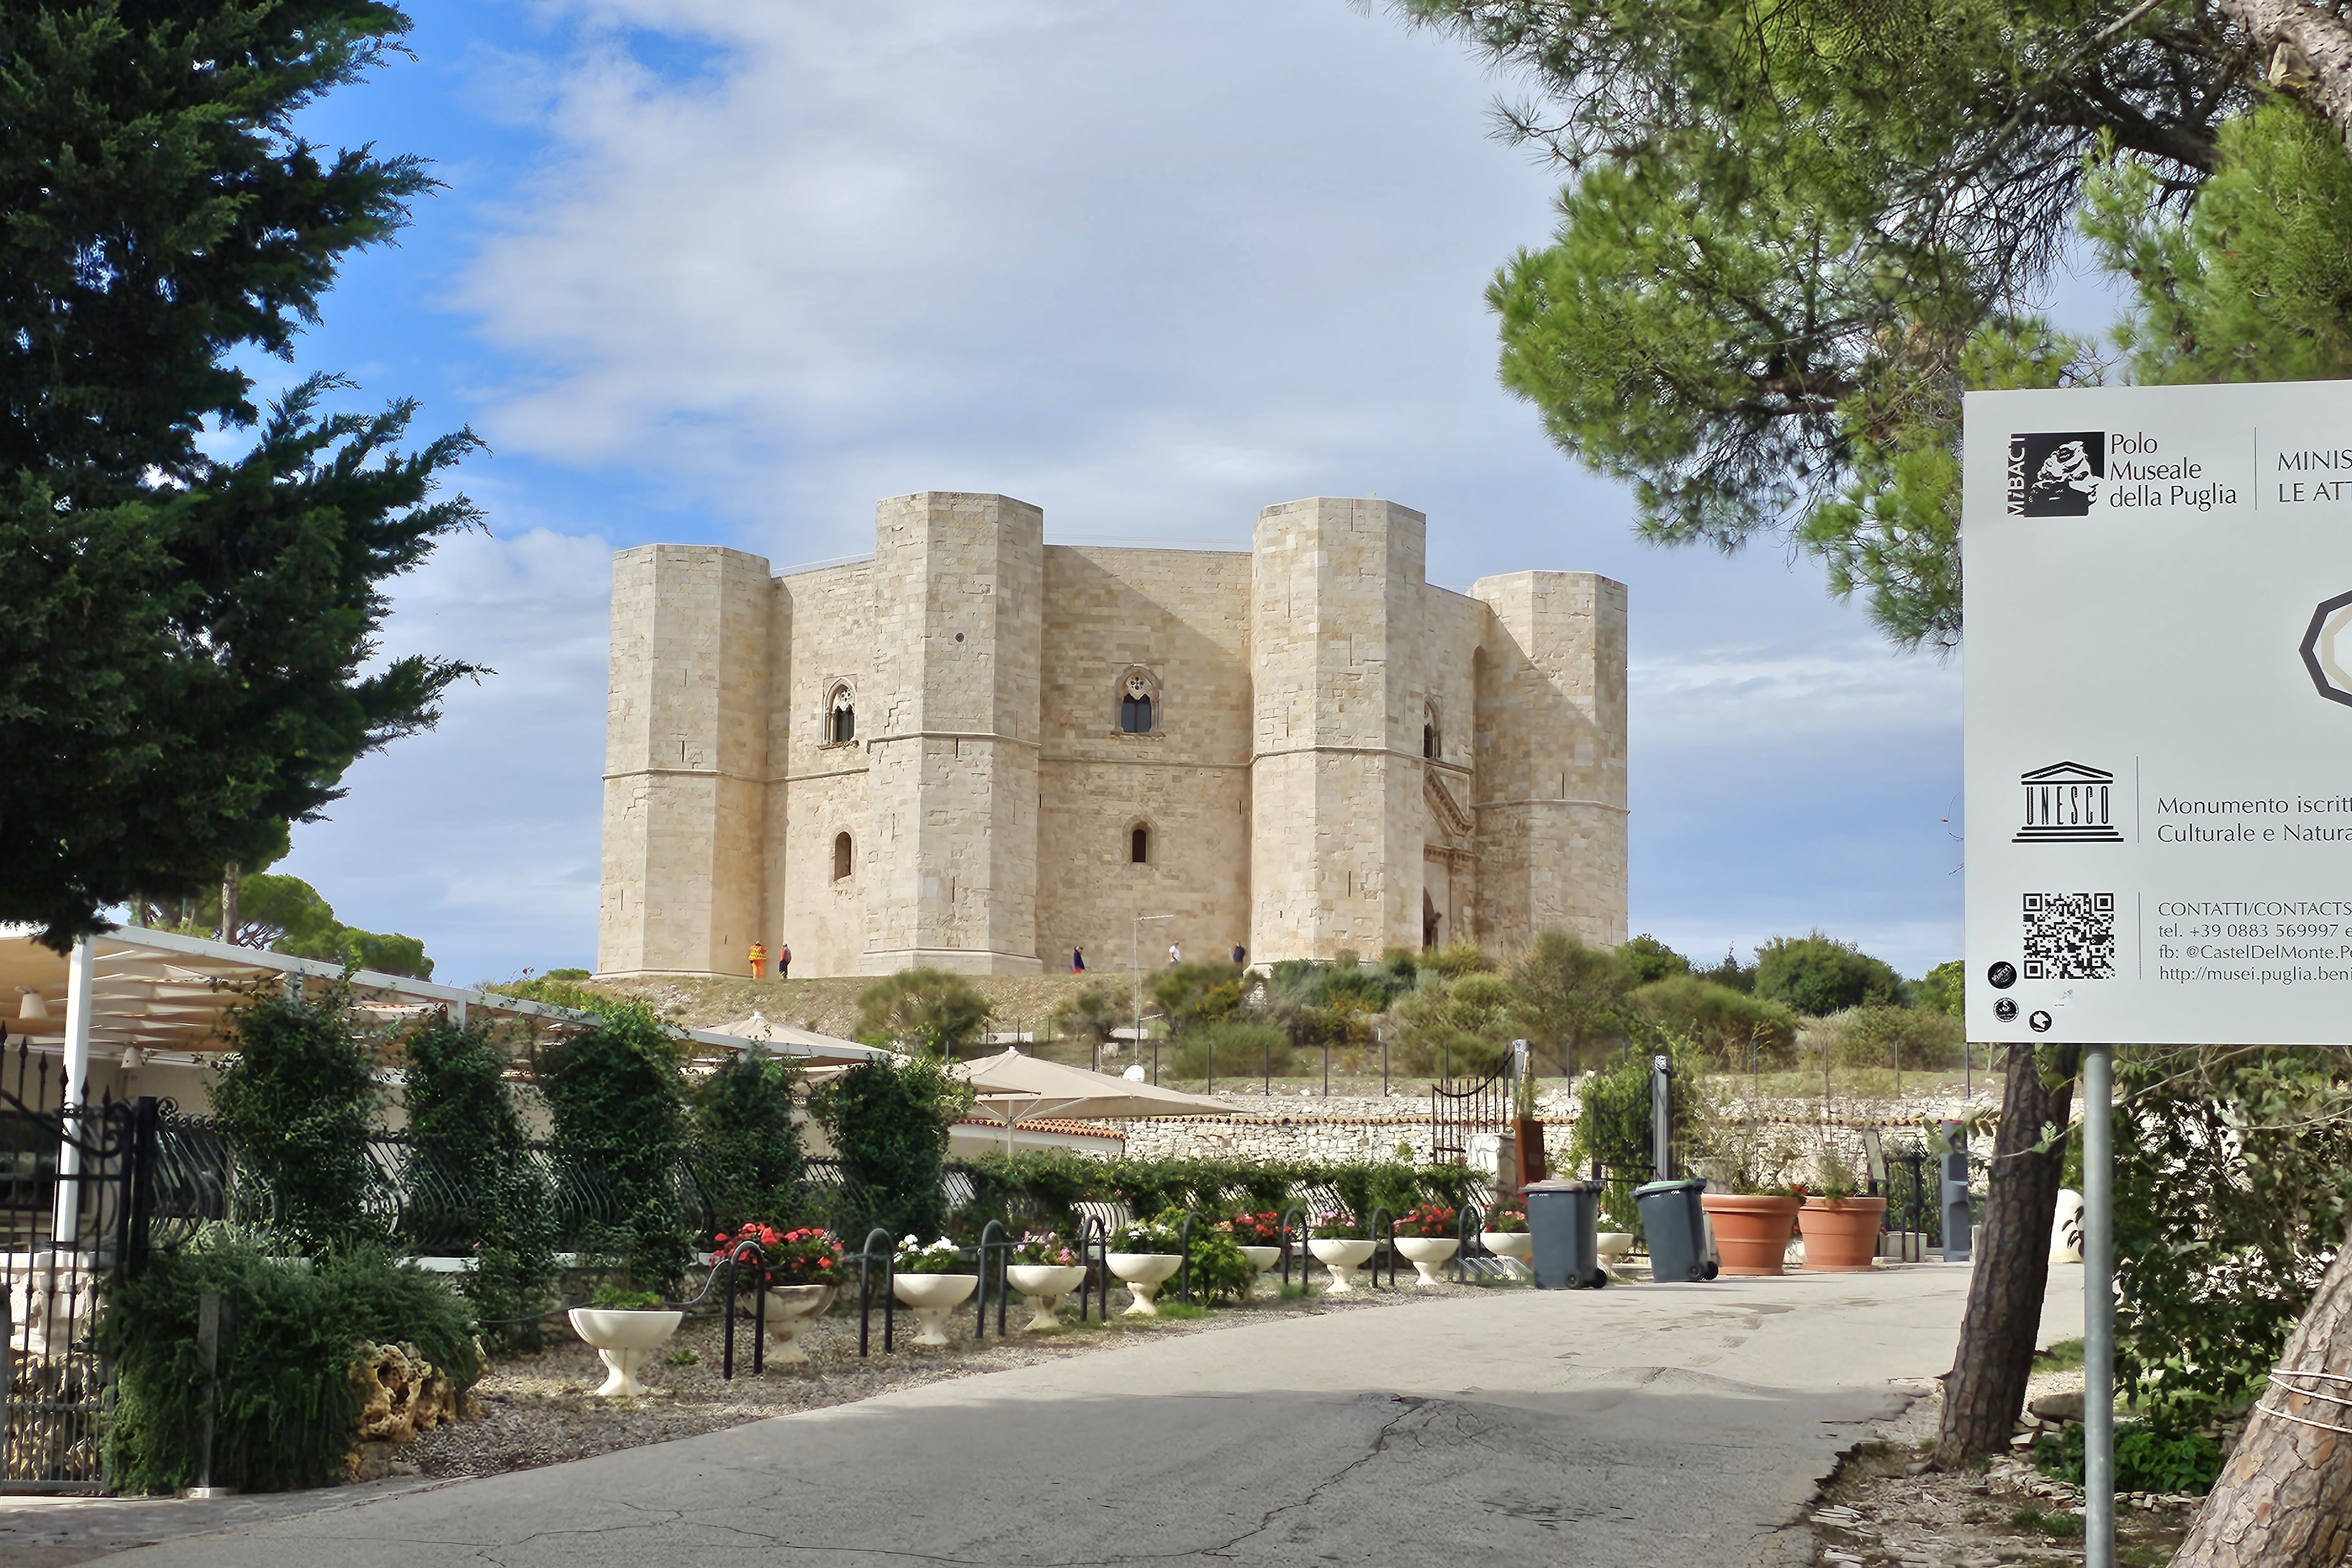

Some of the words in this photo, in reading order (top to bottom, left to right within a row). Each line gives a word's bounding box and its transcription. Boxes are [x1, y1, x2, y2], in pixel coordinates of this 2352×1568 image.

[2111, 431, 2158, 454] Polo
[2110, 456, 2202, 481] Museale
[2278, 449, 2352, 471] MINIS
[2110, 484, 2162, 508] della
[2171, 482, 2237, 512] Puglia
[2279, 482, 2305, 503] LE
[2026, 785, 2110, 825] UNESCO
[2157, 797, 2289, 815] Monumento
[2157, 823, 2255, 843] Culturale
[2263, 829, 2275, 841] e
[2284, 823, 2352, 841] Natura
[2158, 902, 2352, 916] CONTATTI/CONTACTS
[2158, 923, 2183, 937] tel.
[2190, 924, 2222, 937] +39
[2227, 924, 2269, 937] 0883
[2275, 923, 2339, 937] 569997
[2159, 944, 2179, 958] fb:
[2186, 944, 2352, 960] @CastelDelMonte.P
